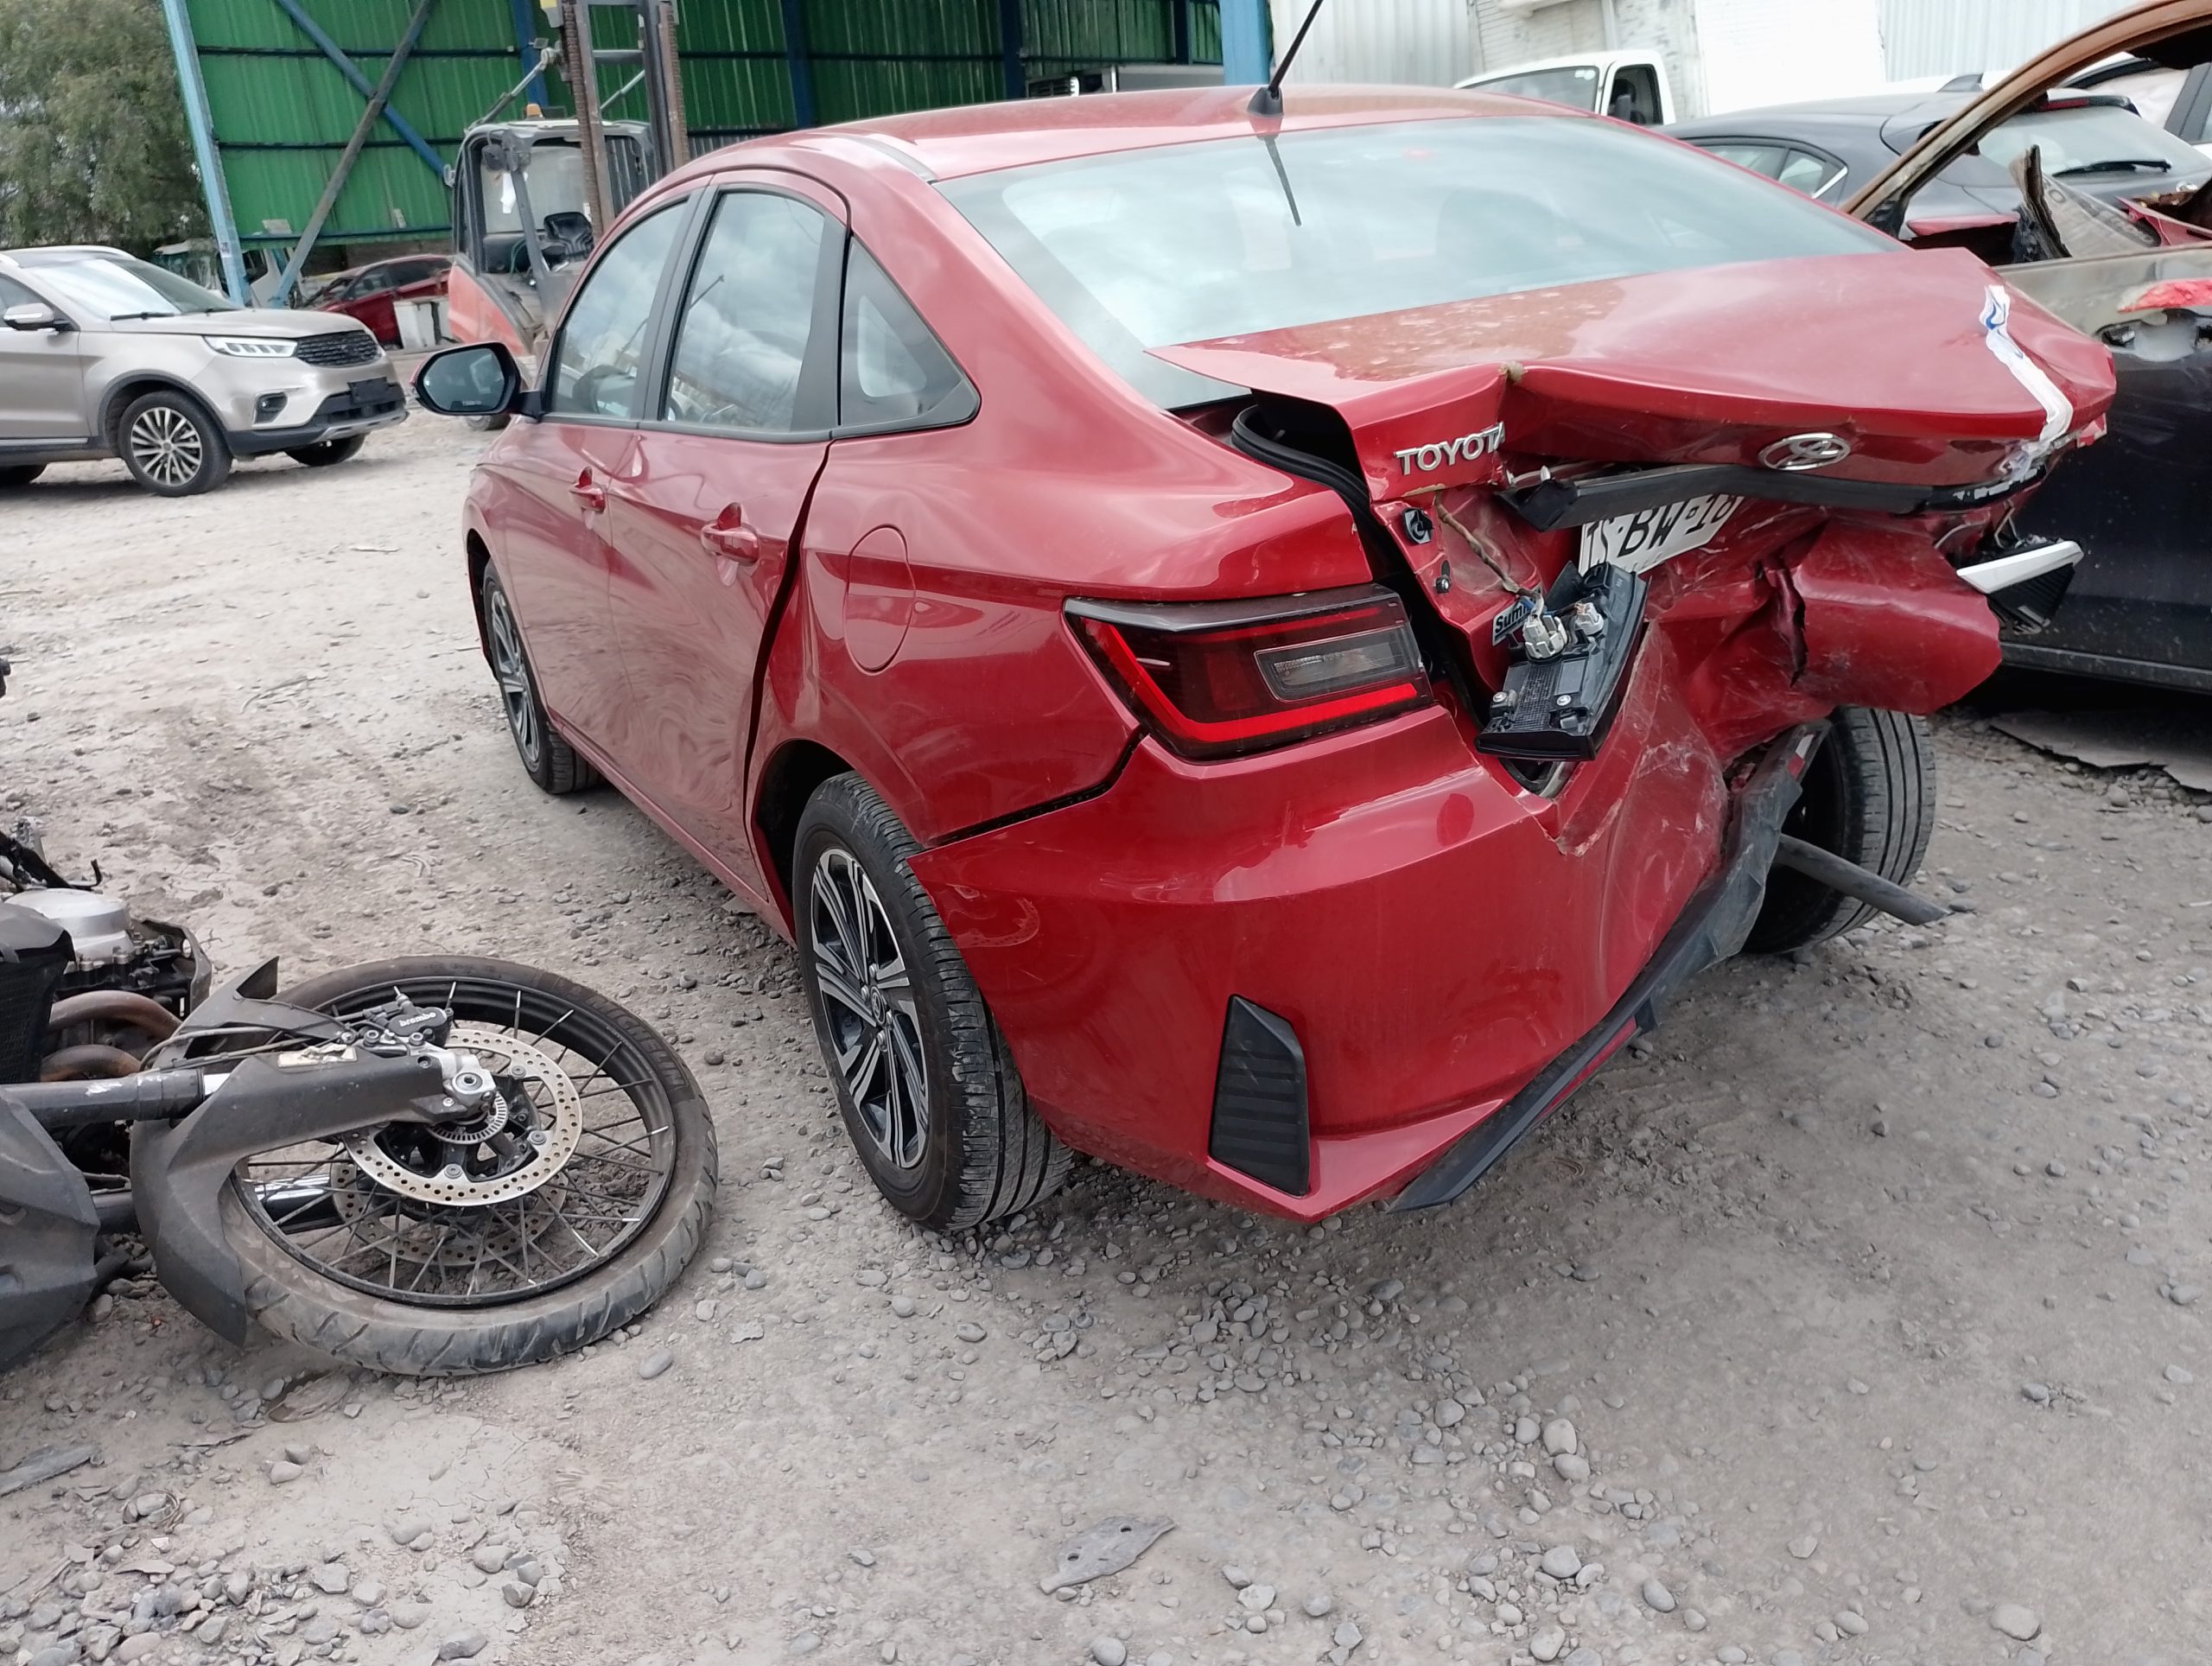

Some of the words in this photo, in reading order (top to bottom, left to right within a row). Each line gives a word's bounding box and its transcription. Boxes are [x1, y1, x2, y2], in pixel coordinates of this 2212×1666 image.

[1394, 421, 1504, 476] TOYOTA
[398, 1012, 436, 1027] brembo
[585, 994, 687, 1088] MICHELIN
